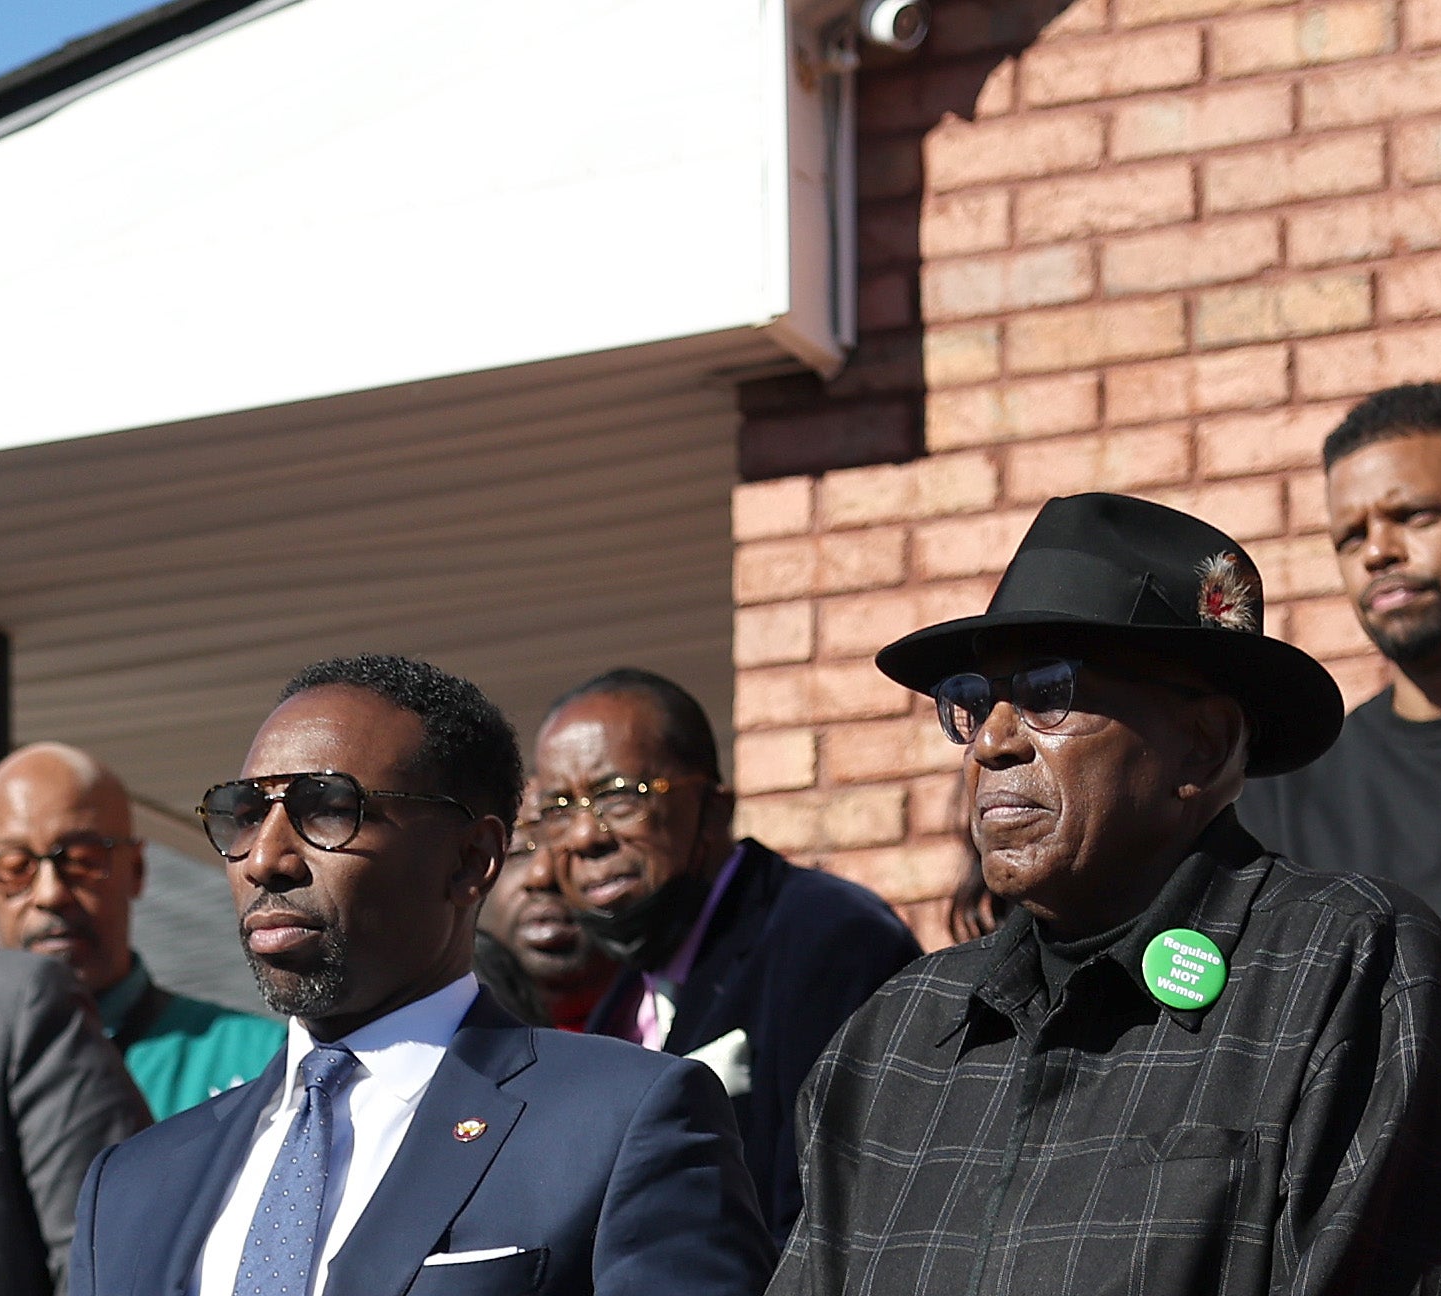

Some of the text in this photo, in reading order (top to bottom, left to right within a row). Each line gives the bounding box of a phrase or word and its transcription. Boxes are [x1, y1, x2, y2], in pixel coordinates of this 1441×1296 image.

[1163, 936, 1220, 966] Regulate
[1172, 954, 1205, 973] Guns
[1170, 967, 1200, 985] NOT
[1157, 976, 1204, 1002] Women
